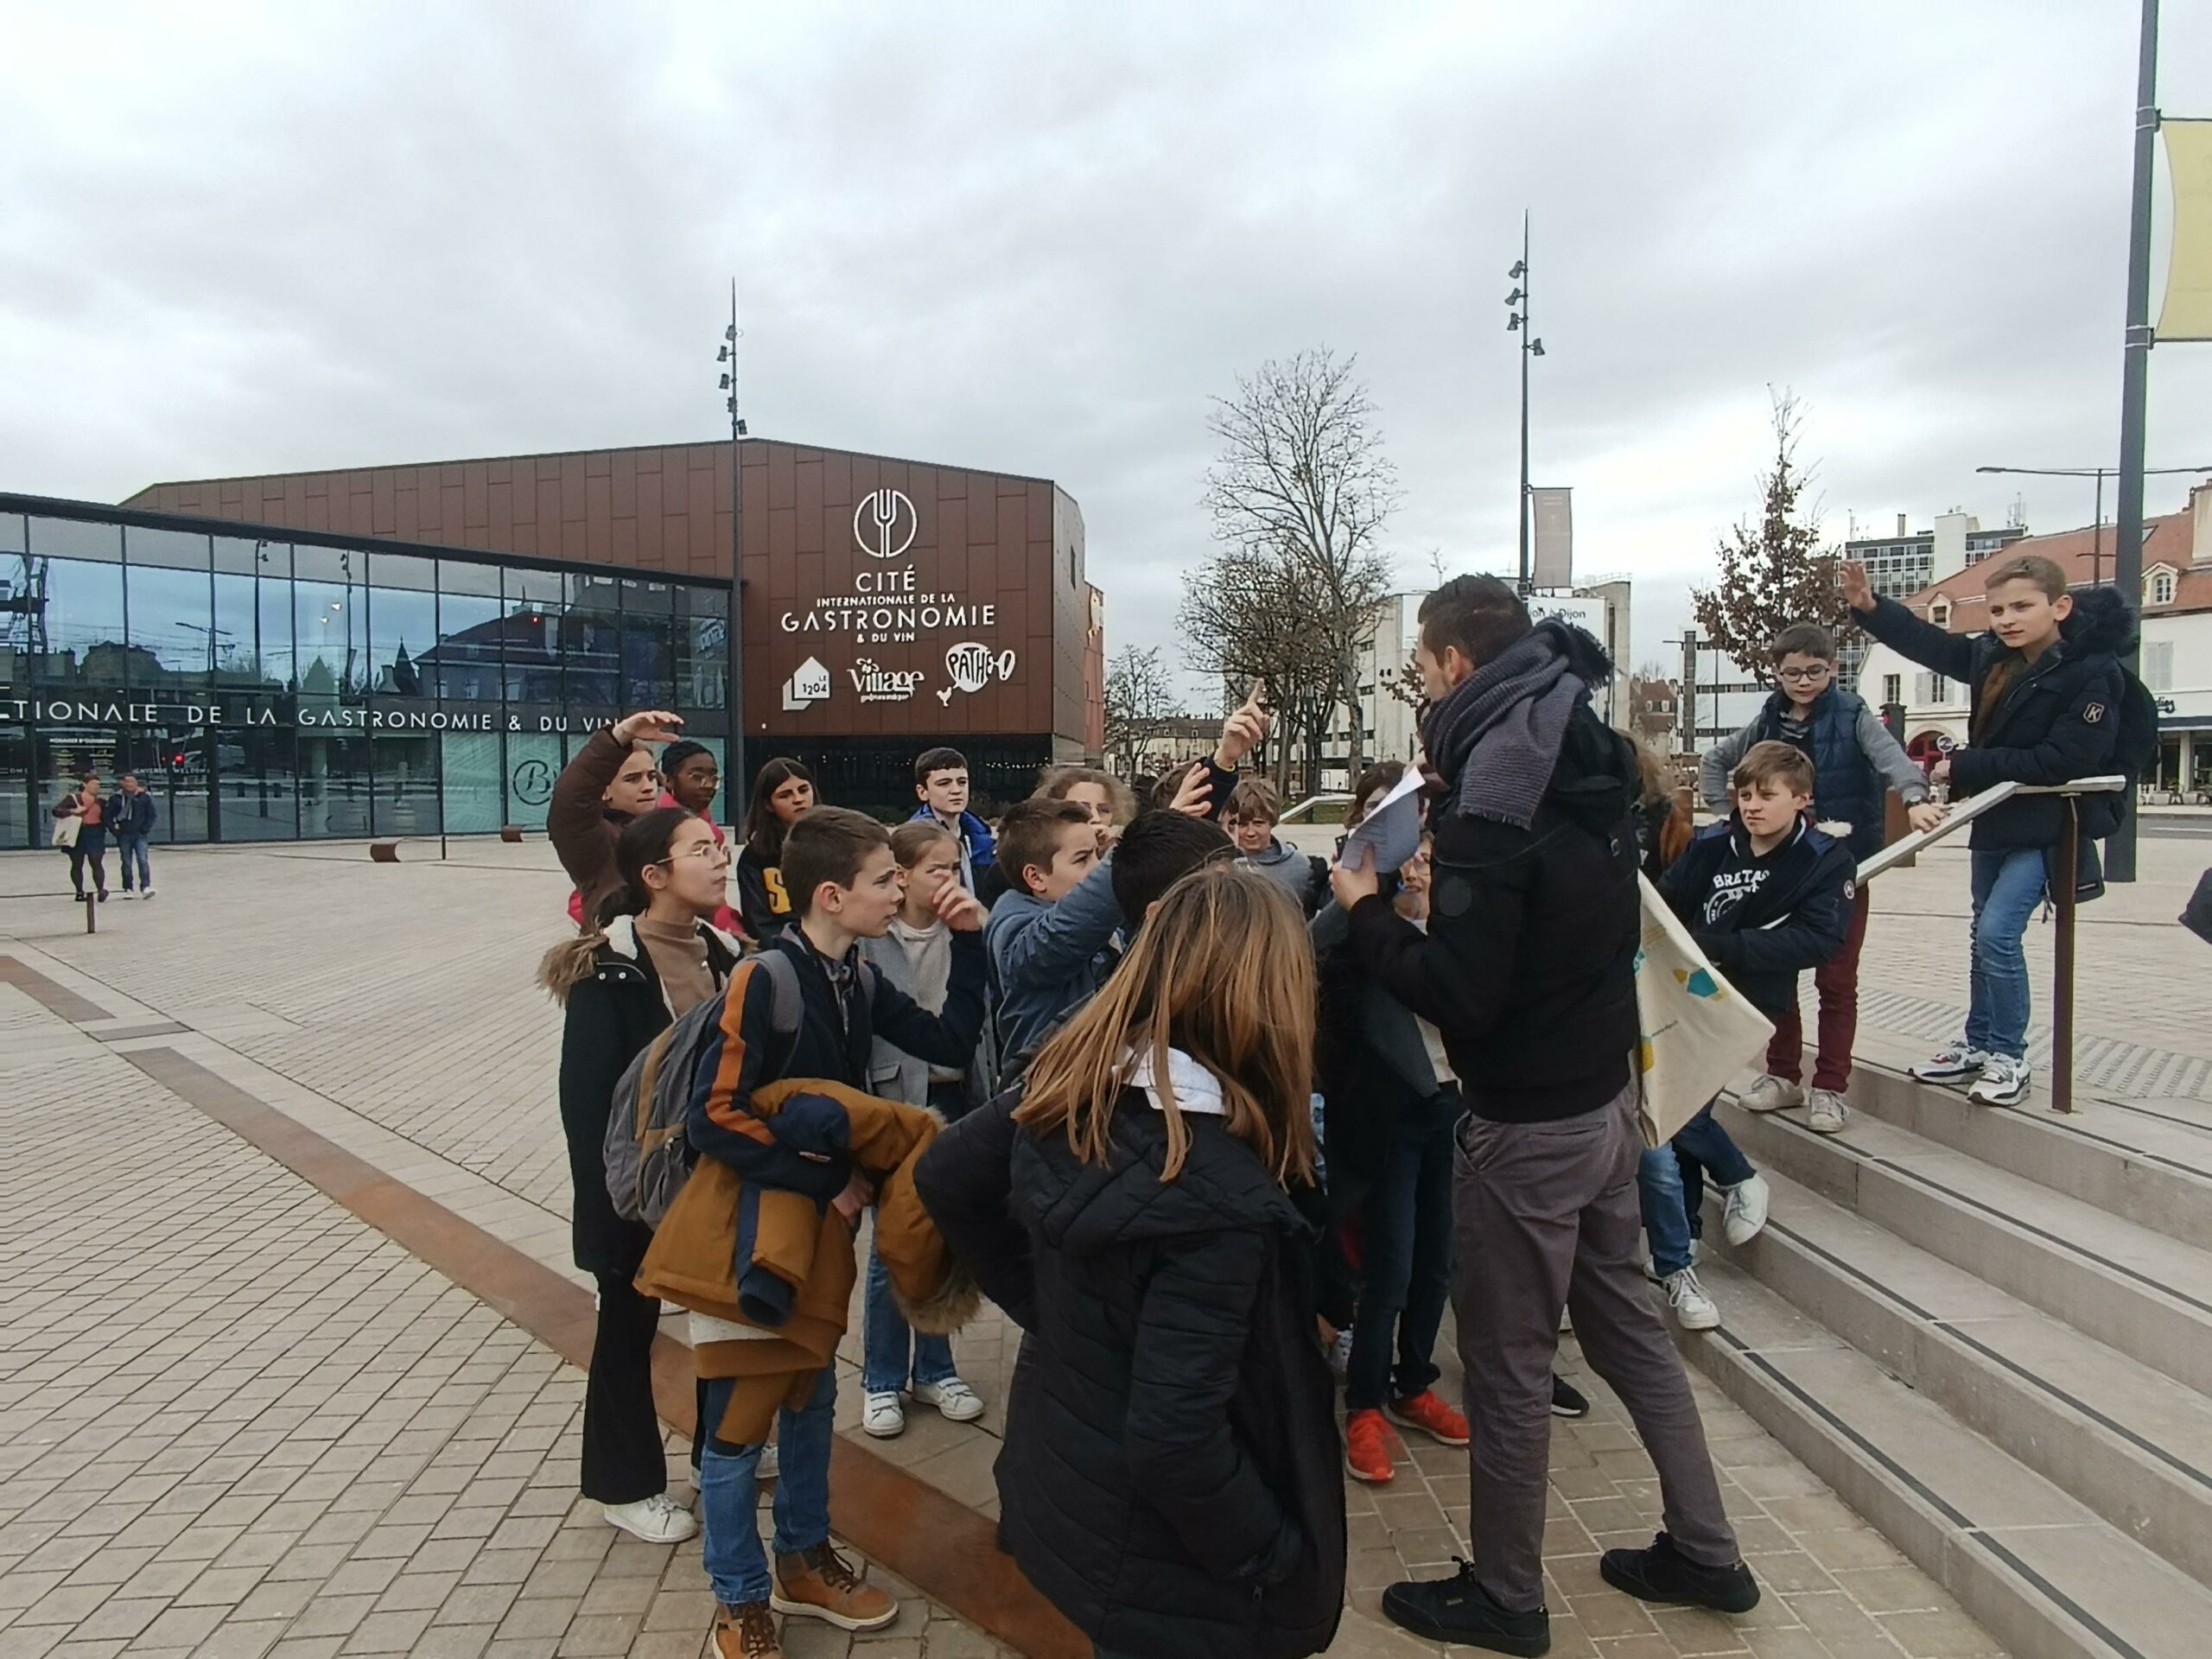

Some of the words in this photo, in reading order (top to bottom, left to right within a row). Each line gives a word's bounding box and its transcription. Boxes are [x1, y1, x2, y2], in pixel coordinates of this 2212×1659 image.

[855, 564, 916, 592] CITÉ
[817, 594, 916, 607] INTERNATIONALE
[920, 594, 936, 604] DE
[940, 593, 956, 603] LA
[781, 604, 995, 632] GASTRONOMIE
[1559, 607, 1586, 620] Dijon
[856, 633, 865, 644] &
[871, 632, 888, 643] DU
[893, 632, 916, 642] VIN
[803, 683, 827, 695] 1204
[846, 668, 925, 698] Village
[0, 700, 157, 722] TIONALE
[188, 705, 221, 724] DE
[246, 707, 276, 725] LA
[298, 709, 492, 730] GASTRONOMIE
[508, 715, 522, 730] &
[540, 716, 567, 732] DU
